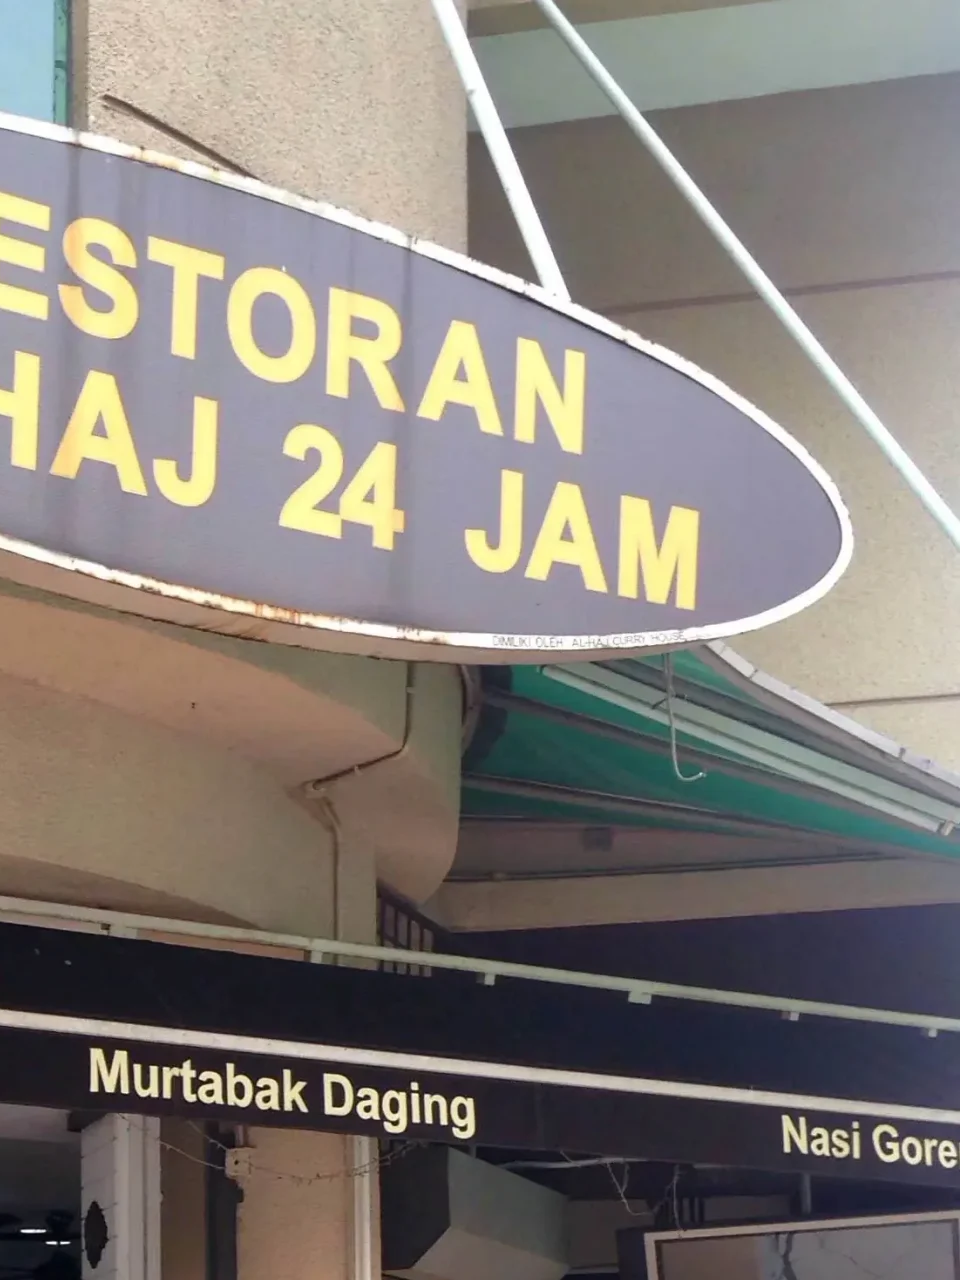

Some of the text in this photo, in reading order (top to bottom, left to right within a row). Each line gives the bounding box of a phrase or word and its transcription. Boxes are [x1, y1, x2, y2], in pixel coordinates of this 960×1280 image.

[278, 423, 406, 551] 24
[464, 470, 701, 612] JAM
[492, 635, 531, 647] DIMILIKI
[535, 636, 564, 648] OLEH
[612, 633, 646, 646] CURRY
[650, 630, 685, 643] HOUSE
[89, 1047, 476, 1140] Murtabak Daging
[781, 1114, 960, 1169] Nasi Gore
